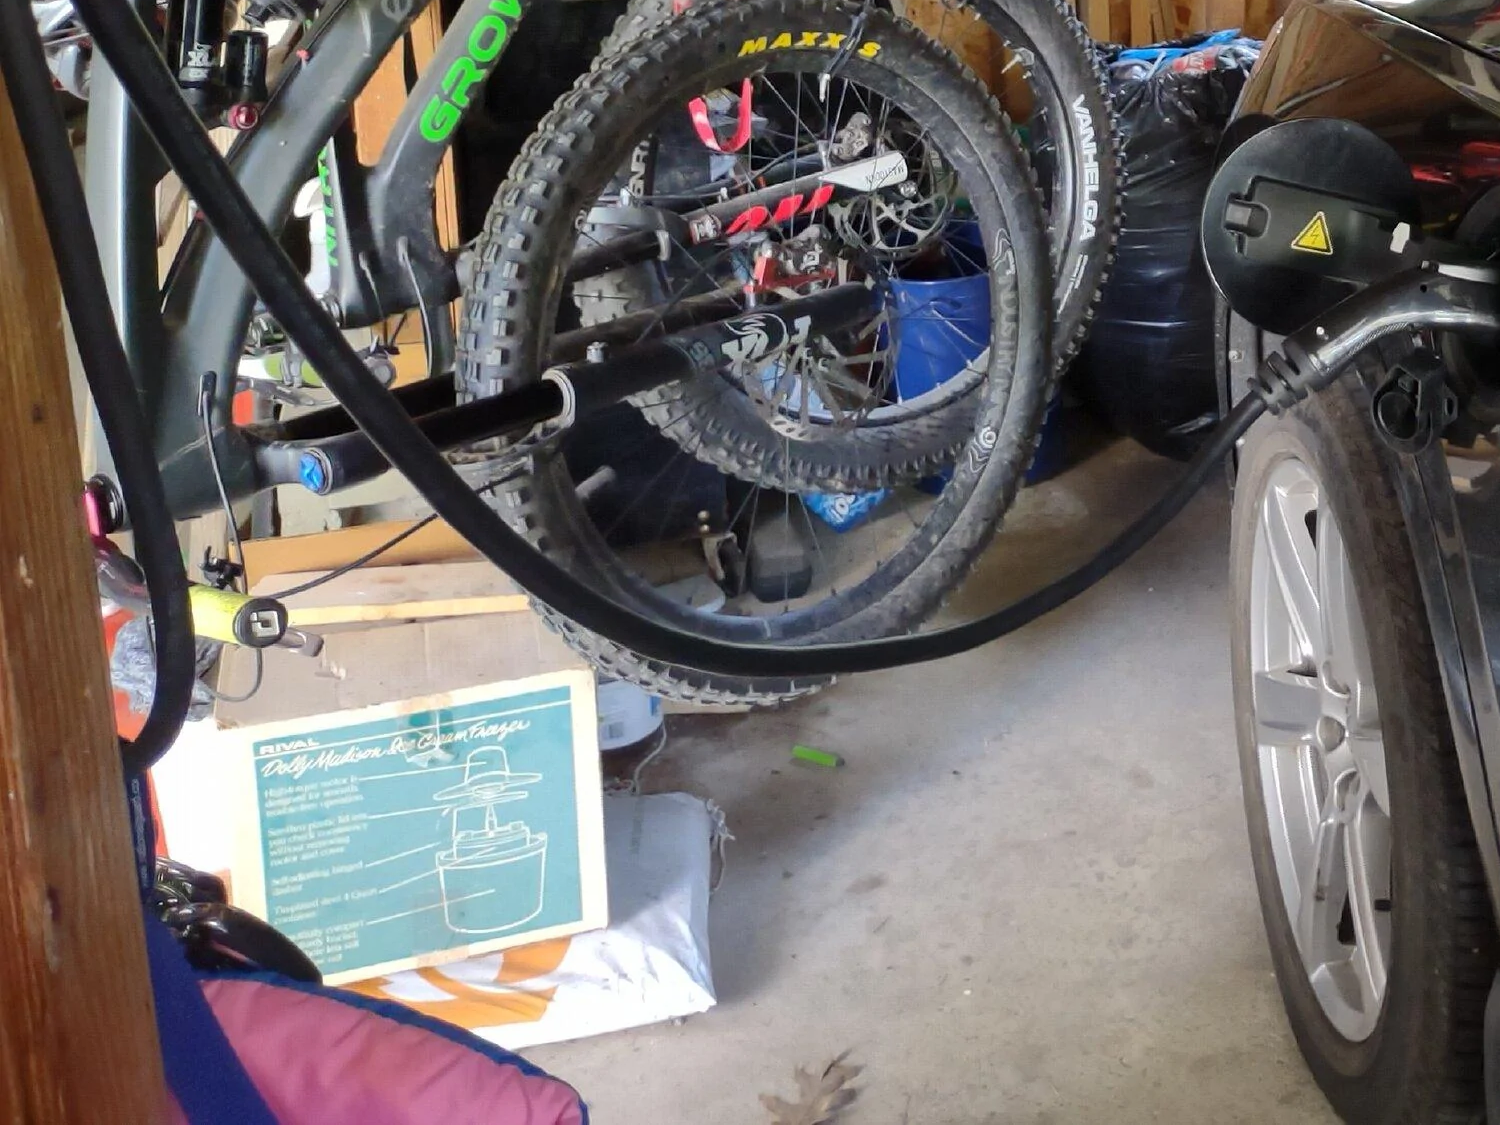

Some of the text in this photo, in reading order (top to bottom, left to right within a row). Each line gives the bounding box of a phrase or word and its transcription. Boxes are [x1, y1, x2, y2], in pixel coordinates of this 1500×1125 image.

[737, 31, 882, 59] MAXXS
[1073, 93, 1099, 243] VANHELGA
[259, 737, 320, 755] RIVAL
[261, 754, 312, 779] Dolly
[308, 743, 384, 771] Madison
[469, 719, 531, 742] Freezer
